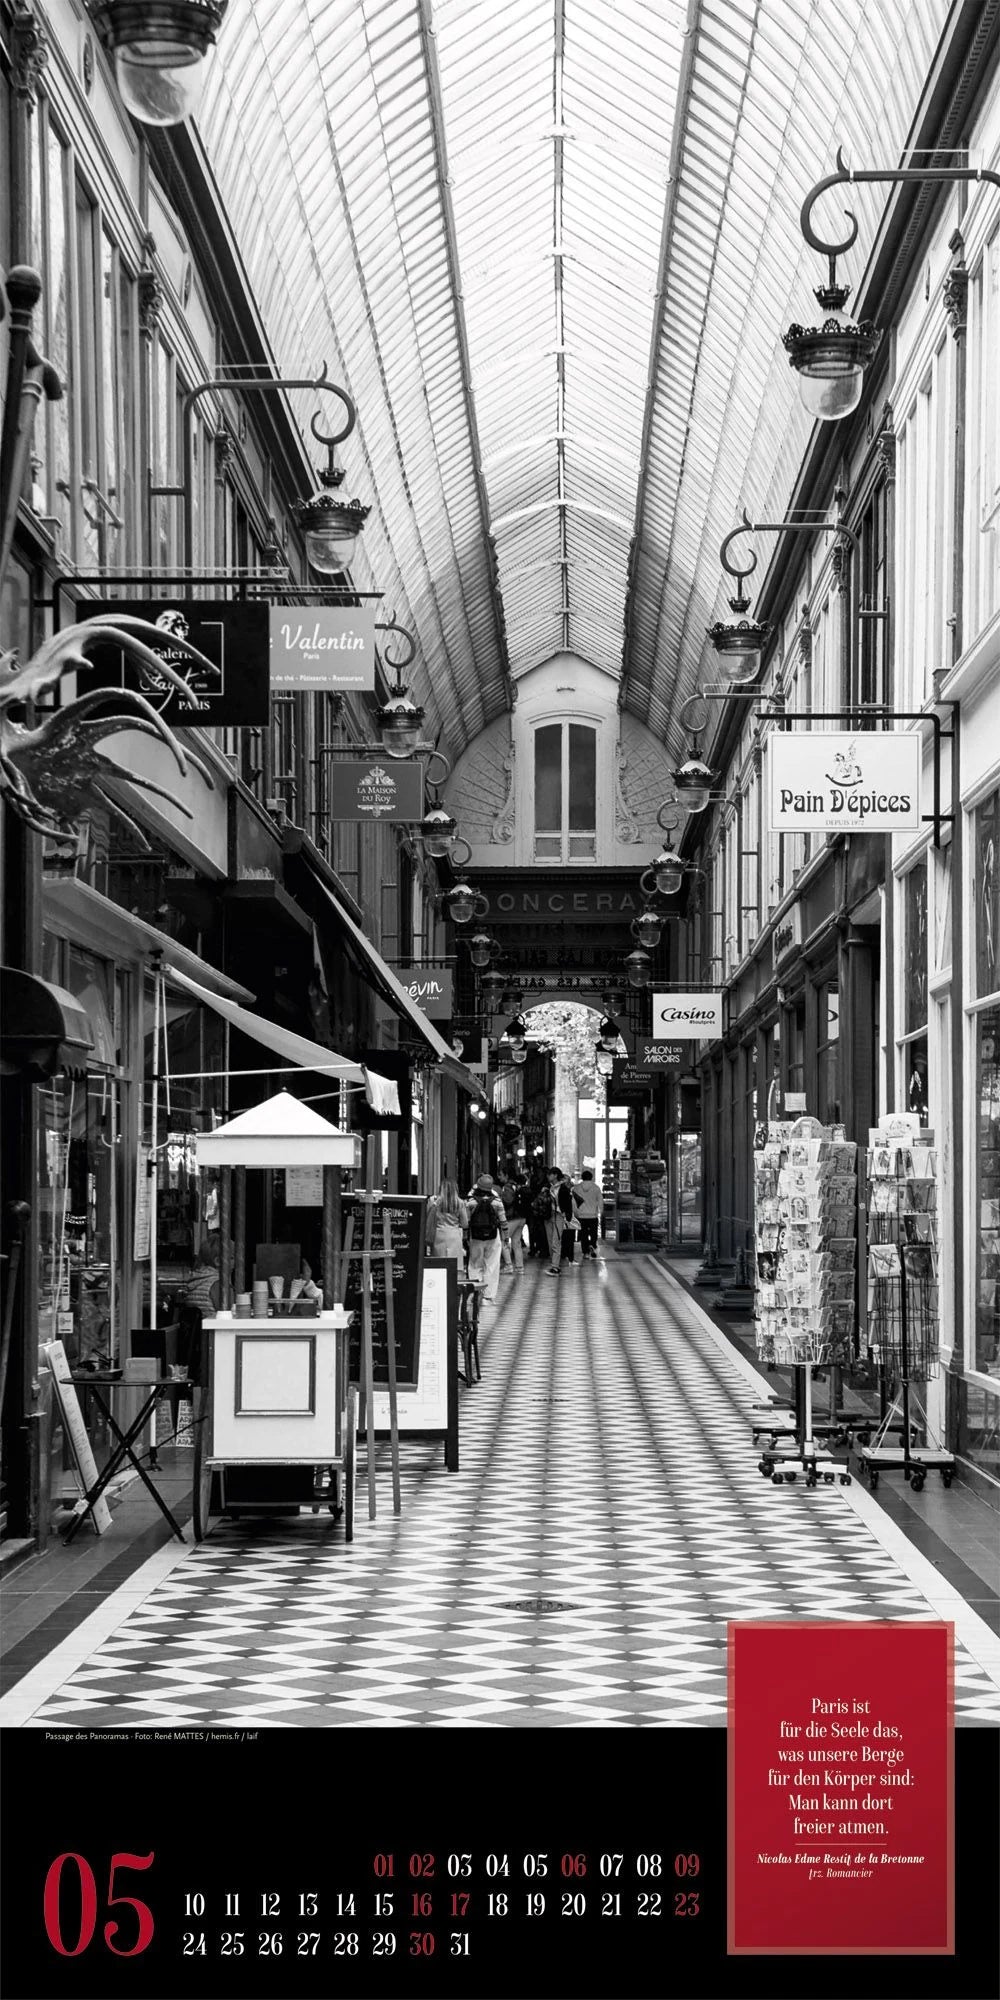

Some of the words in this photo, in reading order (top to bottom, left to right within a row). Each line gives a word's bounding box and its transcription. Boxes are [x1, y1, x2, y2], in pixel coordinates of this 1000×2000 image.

[281, 623, 365, 650] Valentin
[150, 647, 193, 659] Galeri
[303, 652, 320, 660] Paris
[178, 700, 211, 711] PAIS
[780, 789, 824, 813] Pain
[830, 789, 911, 818] D'épices
[660, 1007, 716, 1022] Casino
[643, 1046, 672, 1055] SALON
[643, 1054, 680, 1063] MIROIRS
